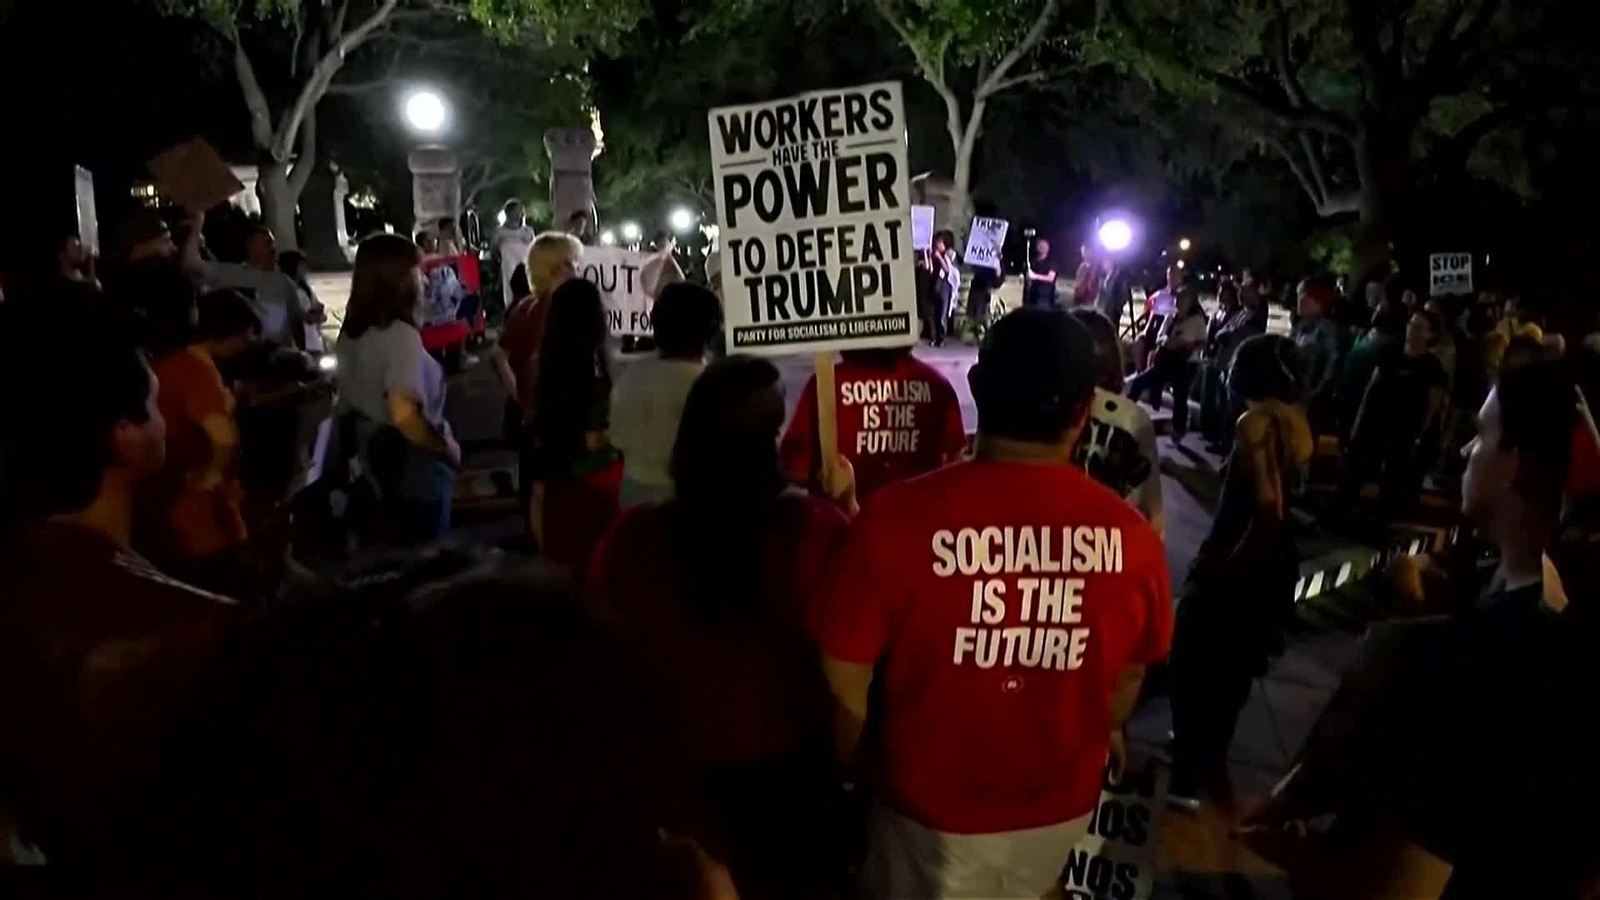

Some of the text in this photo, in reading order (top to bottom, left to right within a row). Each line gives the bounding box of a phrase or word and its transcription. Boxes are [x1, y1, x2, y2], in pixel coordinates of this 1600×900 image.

[716, 89, 894, 155] WORKERS
[772, 139, 840, 166] HAVE THE
[722, 152, 899, 228] POWER
[728, 220, 902, 276] TO DEFEAT
[1432, 256, 1469, 271] STOP
[583, 263, 640, 294] OUT
[743, 263, 893, 323] TRUMP!
[737, 328, 767, 343] PARTY
[768, 327, 786, 341] FOR
[787, 323, 838, 339] SOCIALISM
[849, 317, 906, 334] LIBERATION
[841, 379, 932, 406] SOCIALISM
[862, 404, 916, 429] IS THE
[856, 429, 920, 454] FUTURE
[931, 525, 1124, 578] SOCIALISM
[970, 577, 1085, 625] IS THE
[953, 626, 1091, 671] FUTURE
